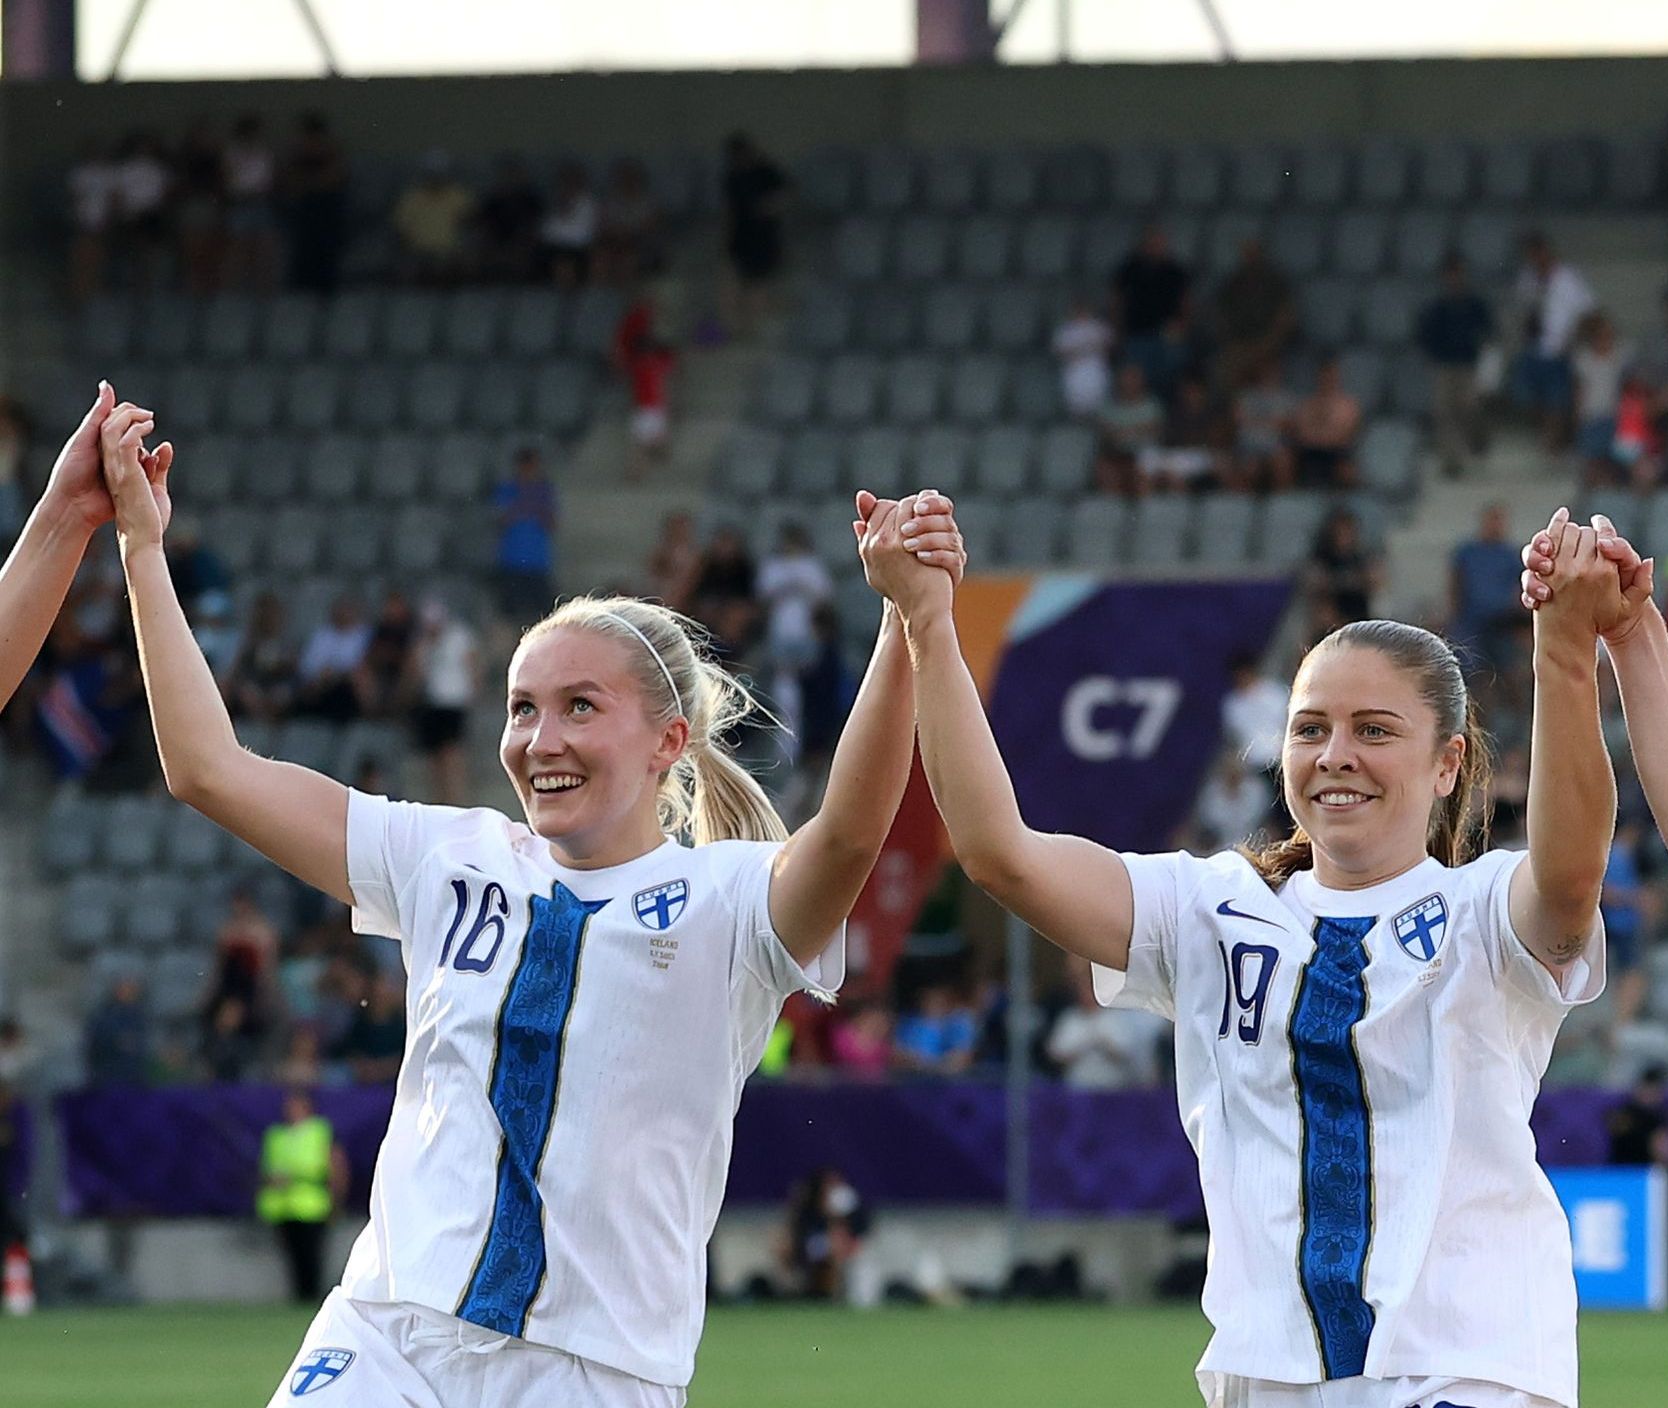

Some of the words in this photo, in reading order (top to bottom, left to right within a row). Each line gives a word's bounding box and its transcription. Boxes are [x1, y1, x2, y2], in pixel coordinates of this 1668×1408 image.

[1060, 674, 1183, 761] C7
[438, 879, 510, 975] 16
[1400, 900, 1435, 925] SUOMI
[1217, 940, 1280, 1045] 19
